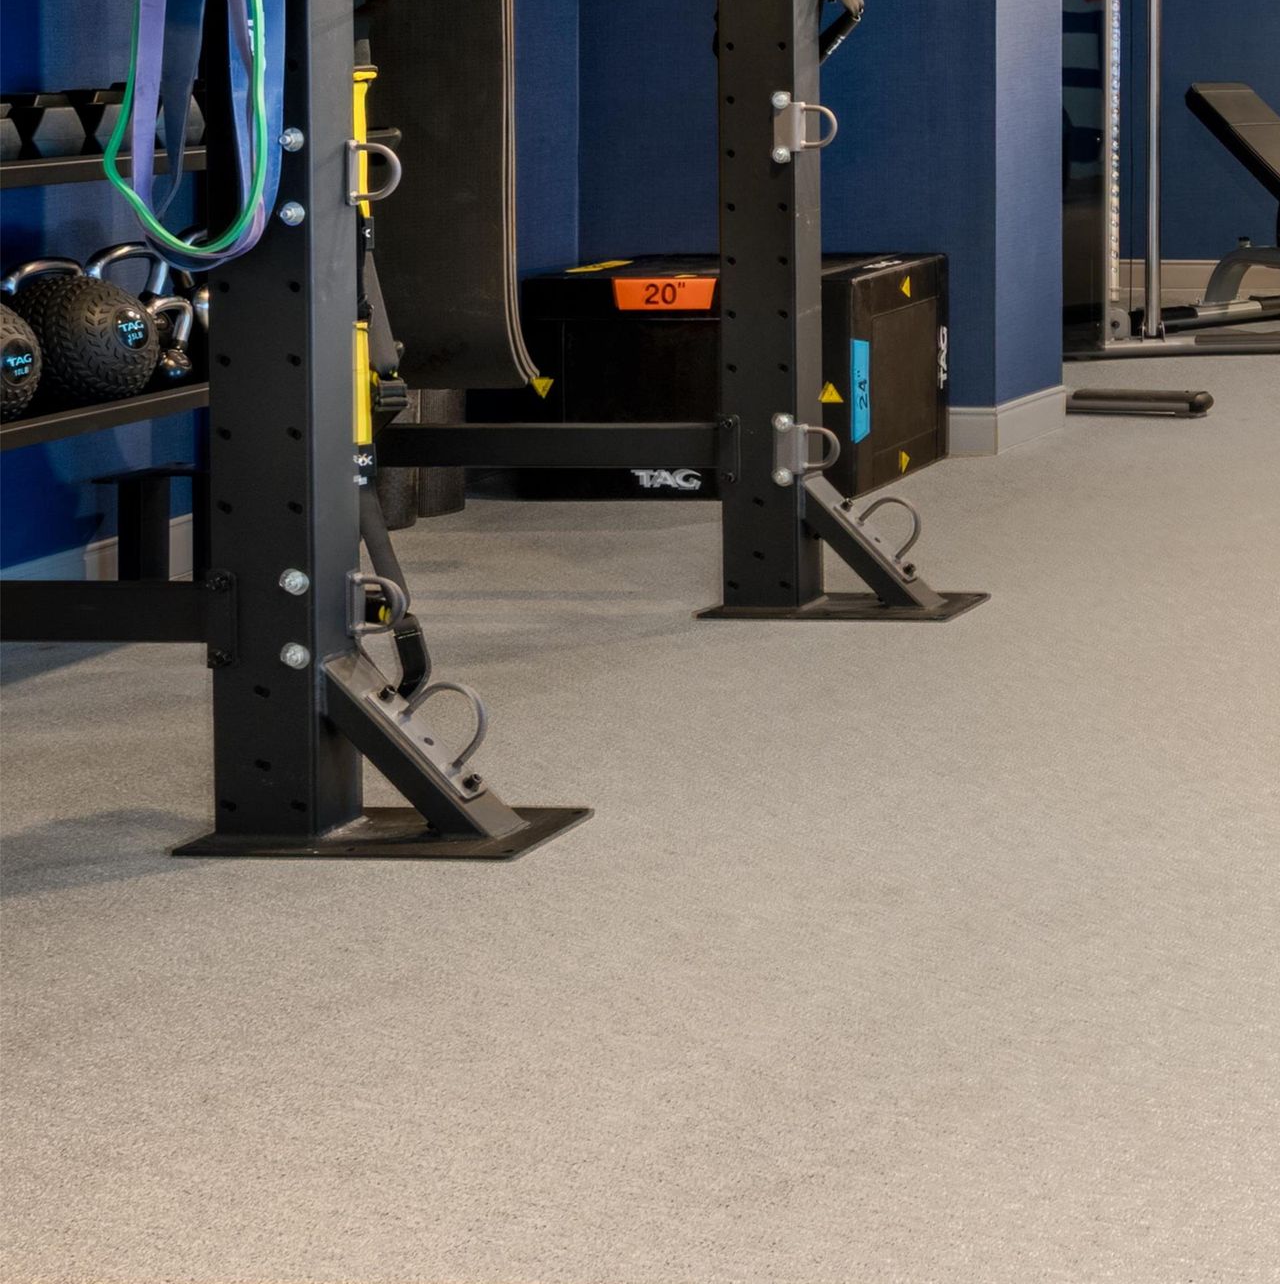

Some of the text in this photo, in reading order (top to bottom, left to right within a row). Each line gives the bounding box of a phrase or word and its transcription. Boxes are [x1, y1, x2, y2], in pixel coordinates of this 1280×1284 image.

[644, 281, 686, 306] 20"
[117, 319, 144, 333] TAG
[6, 353, 33, 368] TAG
[857, 370, 869, 411] 24"
[630, 468, 702, 490] TAG
